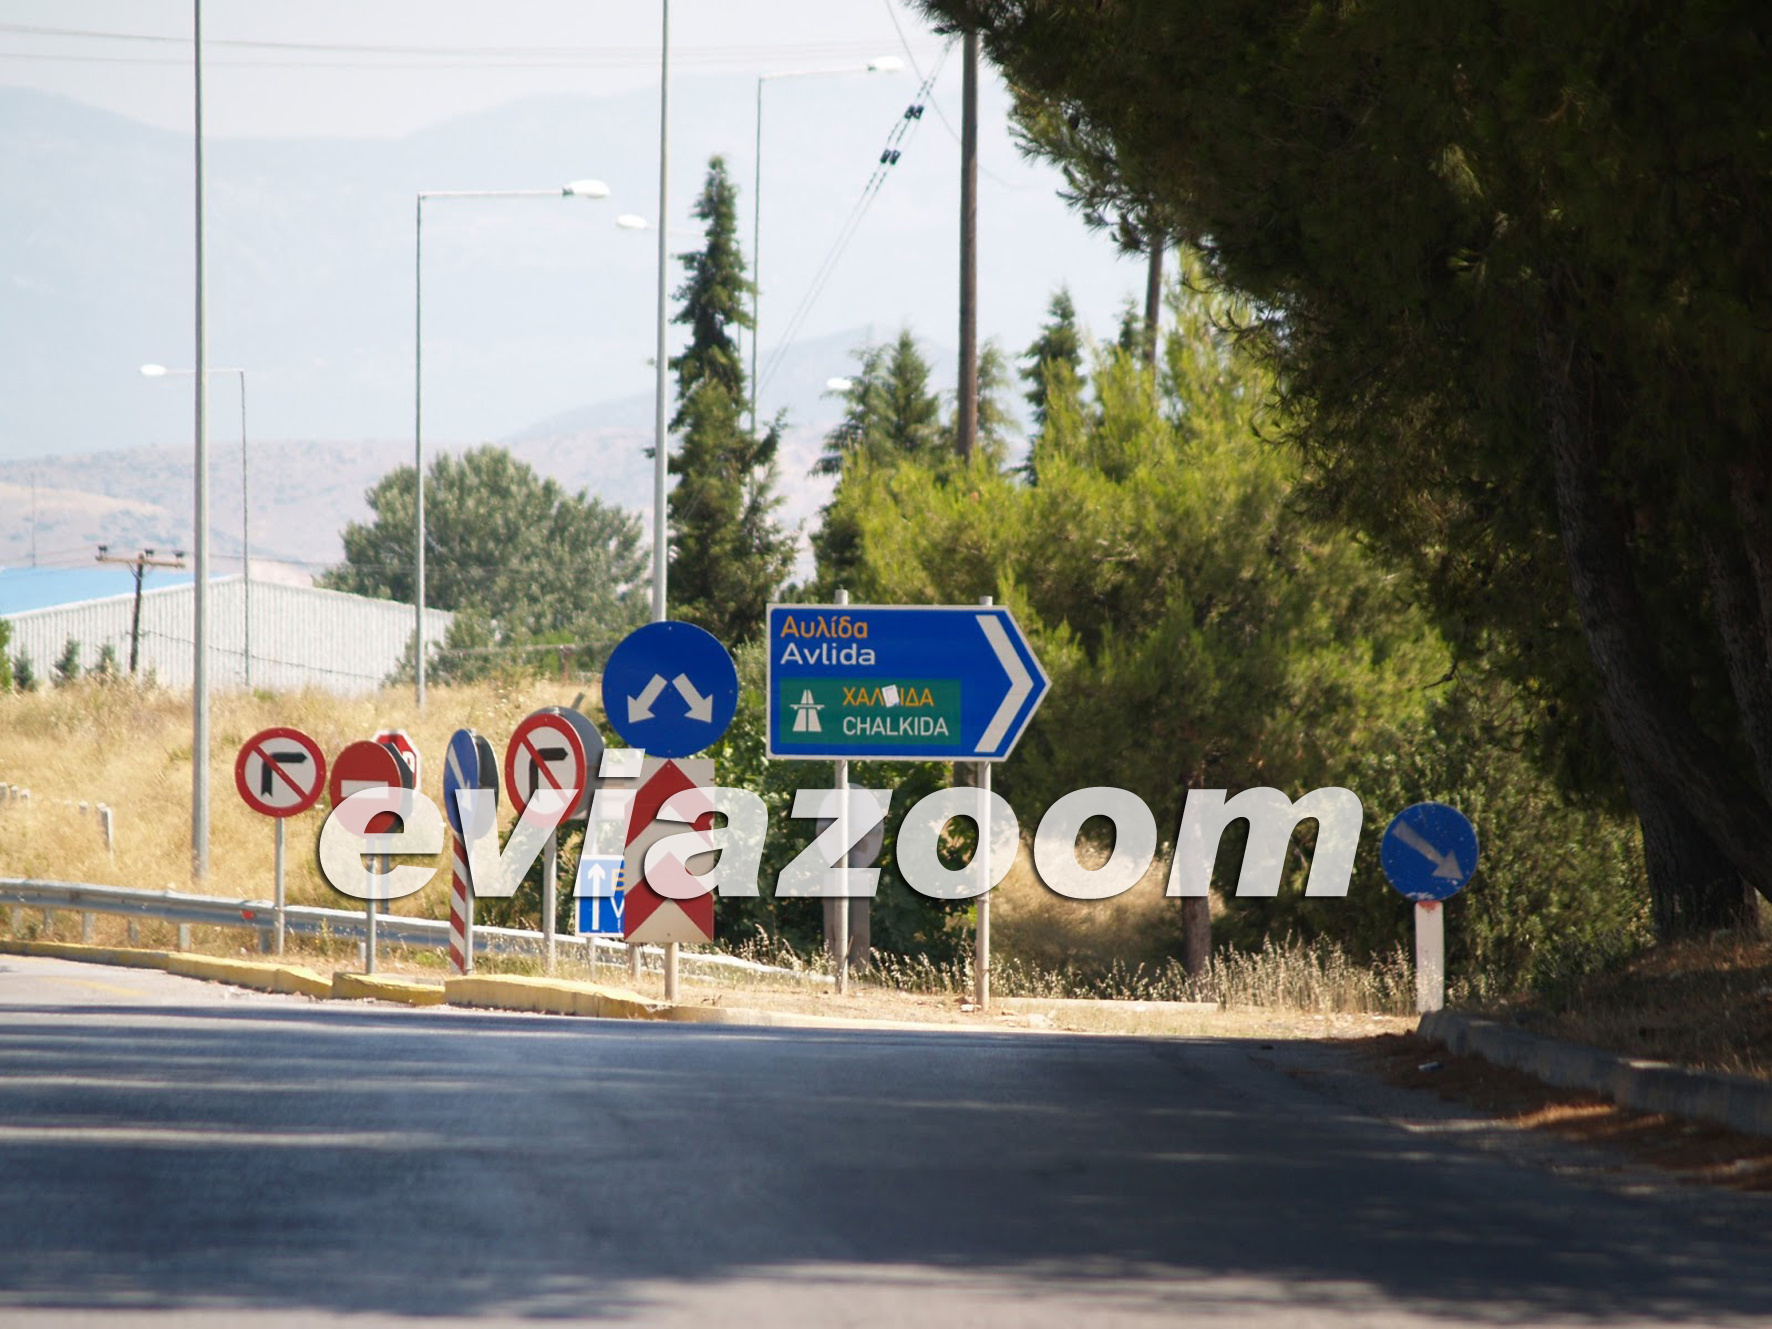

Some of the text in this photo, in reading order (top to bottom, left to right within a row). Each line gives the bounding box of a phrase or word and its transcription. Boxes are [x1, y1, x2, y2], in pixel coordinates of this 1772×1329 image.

[780, 615, 868, 638] Αυλίδα
[780, 642, 876, 665] Avlida
[842, 686, 935, 707] ΧΑΛΙΔΑ
[842, 716, 949, 736] CHALKIDA
